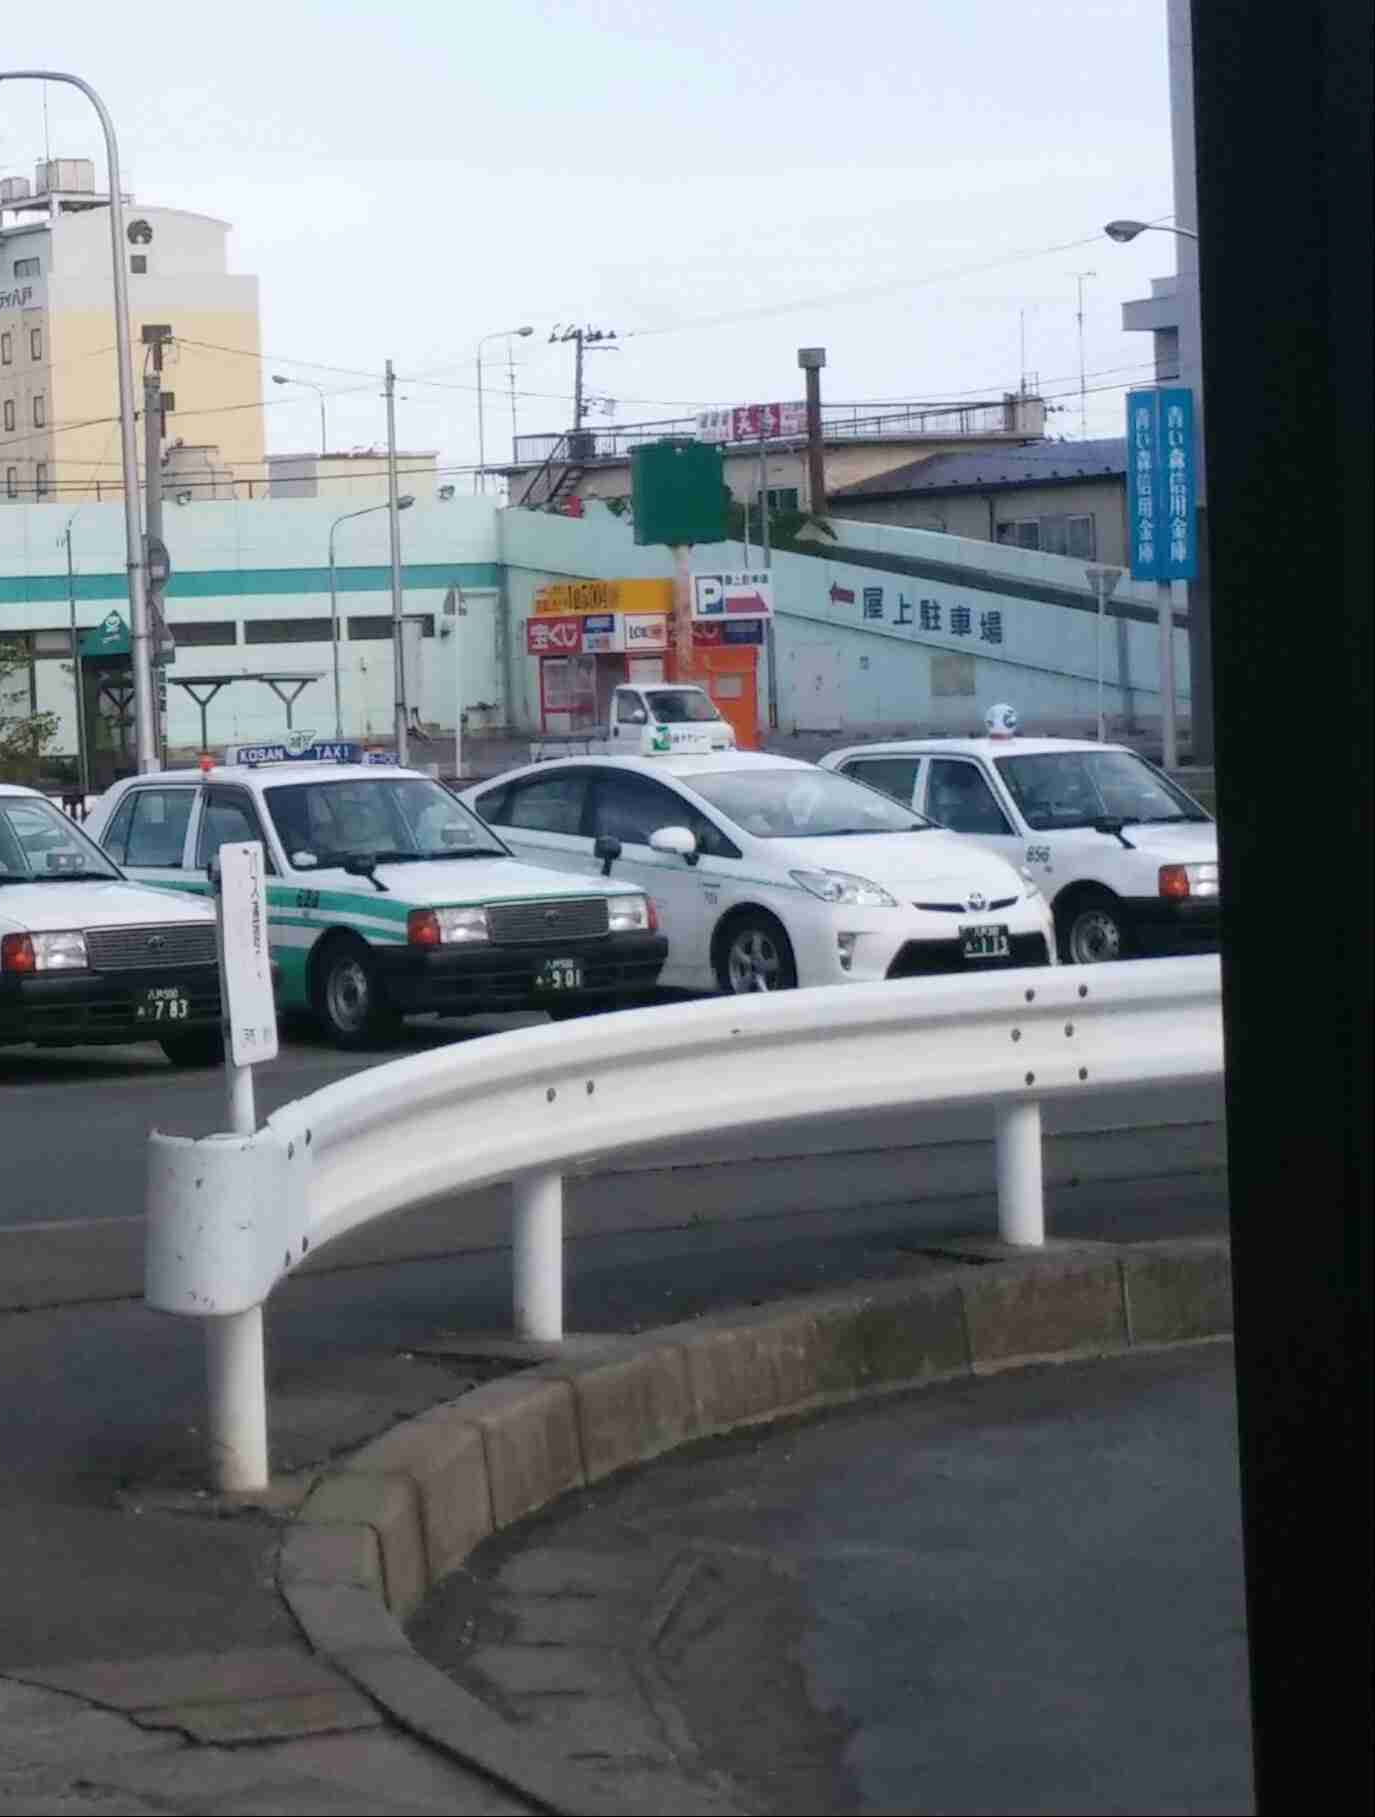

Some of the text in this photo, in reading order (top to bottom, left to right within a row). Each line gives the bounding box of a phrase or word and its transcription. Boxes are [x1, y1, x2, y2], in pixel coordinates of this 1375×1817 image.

[1168, 405, 1187, 563] 青い森信用金庫
[863, 586, 1003, 644] 屋上駐車場
[316, 744, 349, 760] TAXI
